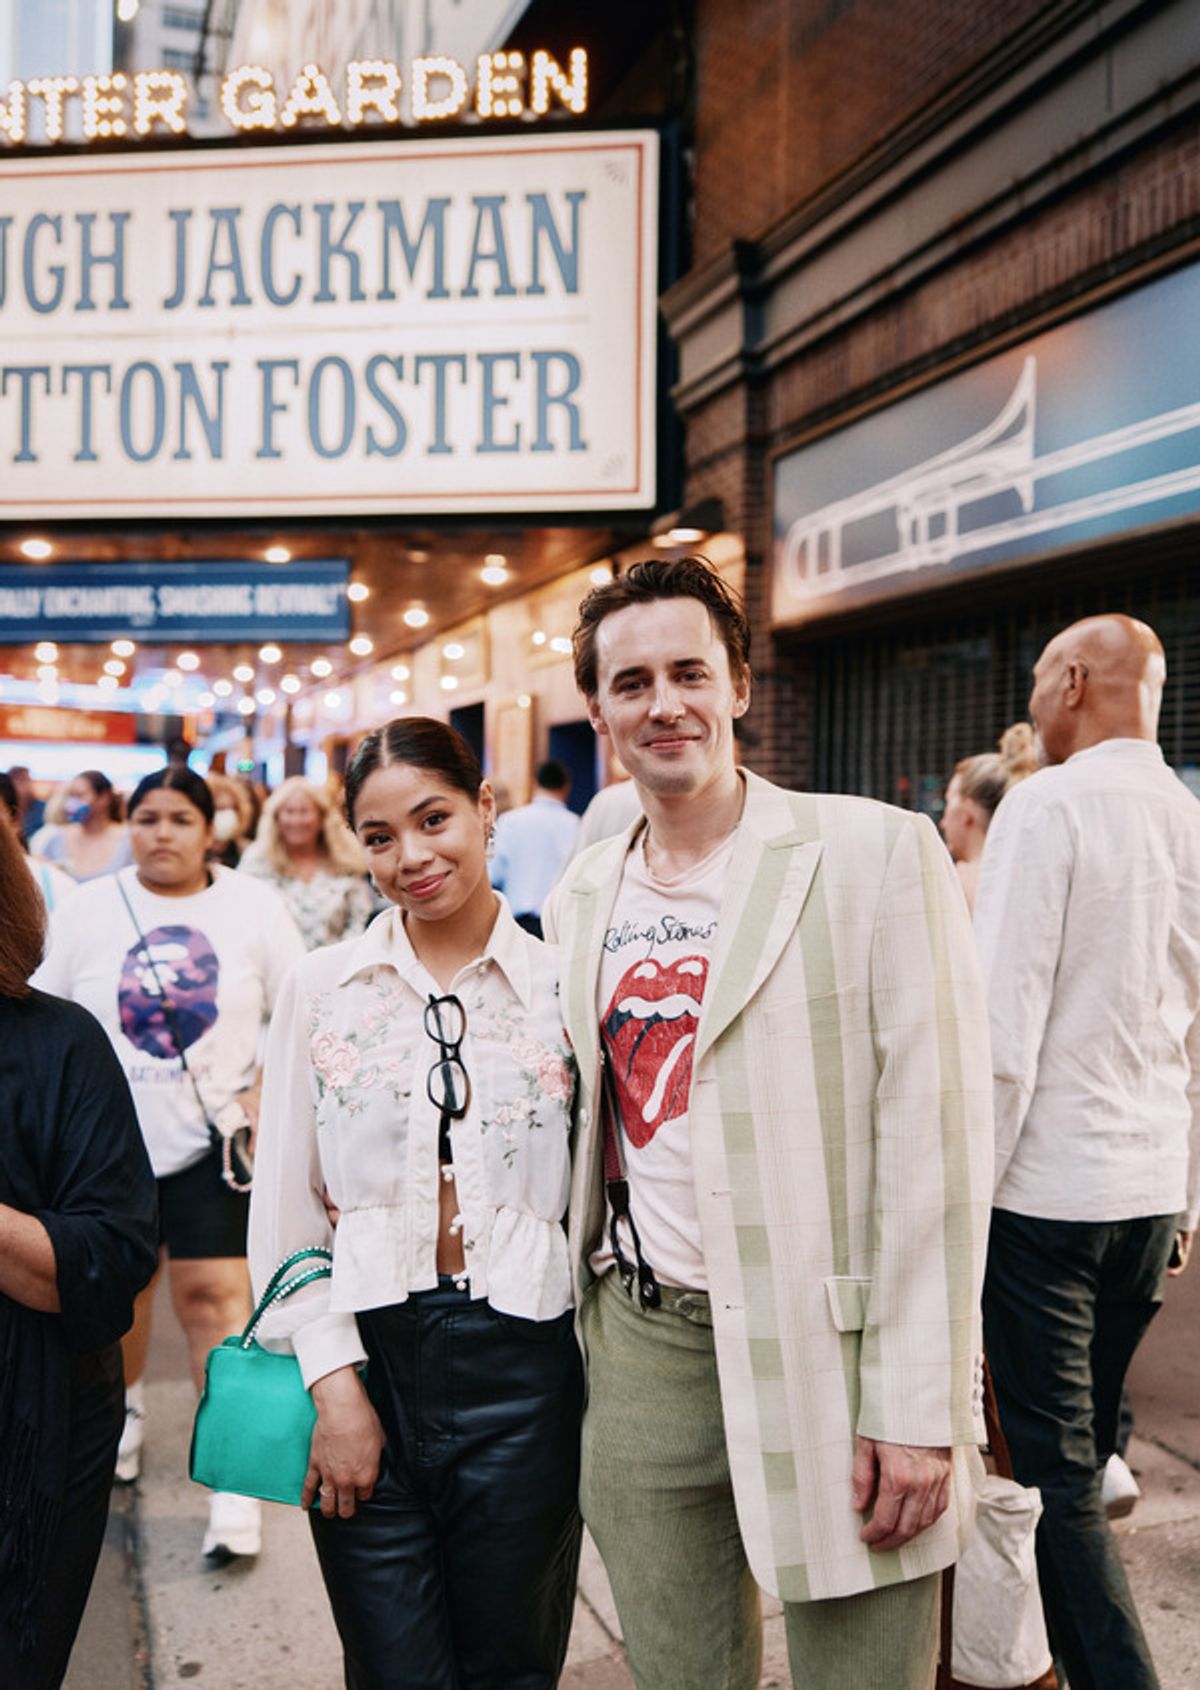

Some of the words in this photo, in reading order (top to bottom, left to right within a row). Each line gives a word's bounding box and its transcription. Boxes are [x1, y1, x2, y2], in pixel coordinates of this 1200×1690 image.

[220, 46, 588, 130] GARDEN
[163, 190, 588, 310] JACKMAN
[2, 360, 230, 463] TTON
[255, 350, 588, 459] FOSTER
[602, 919, 657, 960] Rolling
[655, 914, 718, 945] Stones
